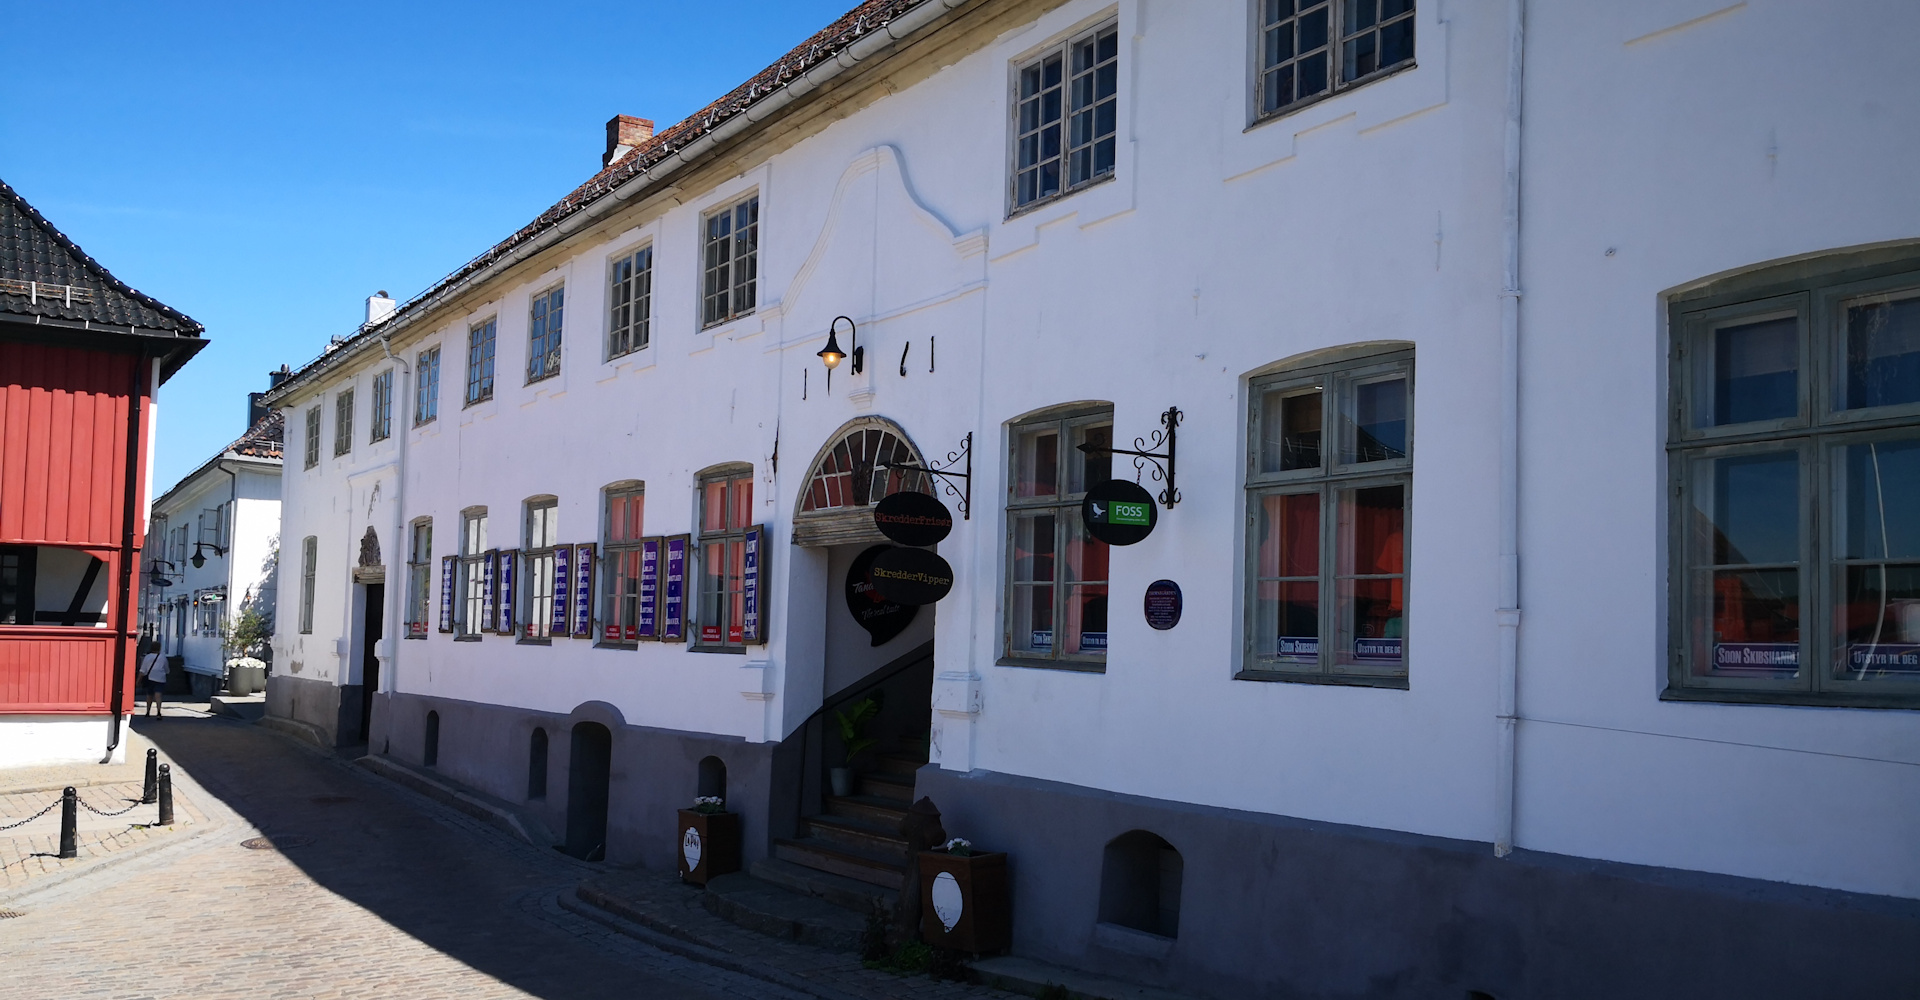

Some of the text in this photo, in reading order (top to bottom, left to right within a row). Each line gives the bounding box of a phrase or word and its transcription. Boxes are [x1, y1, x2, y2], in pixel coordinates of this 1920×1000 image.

[1116, 505, 1143, 518] FOSS
[874, 567, 950, 585] SkredderVipper
[1718, 647, 1741, 664] SOON
[1853, 651, 1918, 665] UTSTYR TIL DEG
